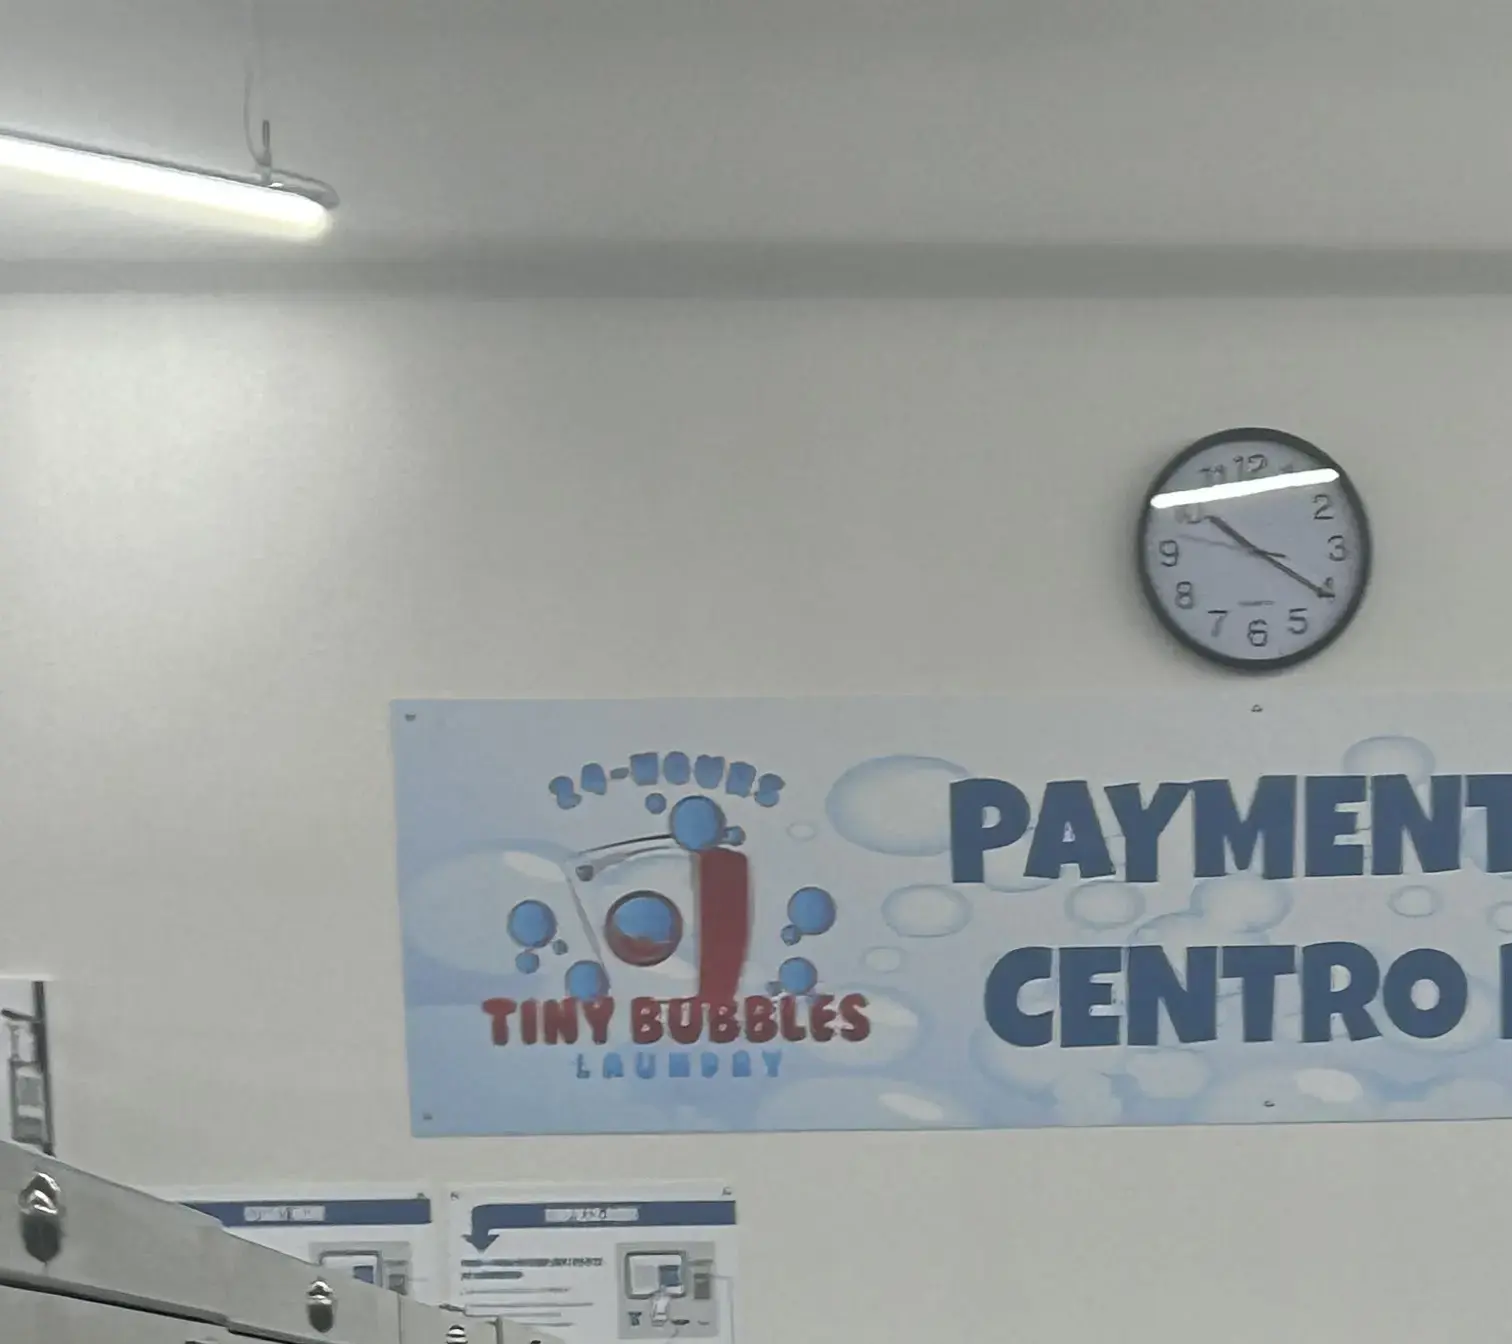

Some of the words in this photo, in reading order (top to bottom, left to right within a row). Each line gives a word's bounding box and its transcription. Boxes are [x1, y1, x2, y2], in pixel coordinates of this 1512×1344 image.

[1232, 454, 1268, 481] 12
[1313, 494, 1334, 520] 2
[1159, 539, 1179, 567] 9
[1327, 535, 1346, 562] 3
[1175, 581, 1194, 609] 8
[1208, 609, 1229, 637] 7
[1247, 618, 1268, 647] 6
[1288, 608, 1308, 635] 5
[983, 941, 1468, 1048] CENTRO
[482, 995, 615, 1046] TINY
[630, 992, 871, 1045] BUBBLES
